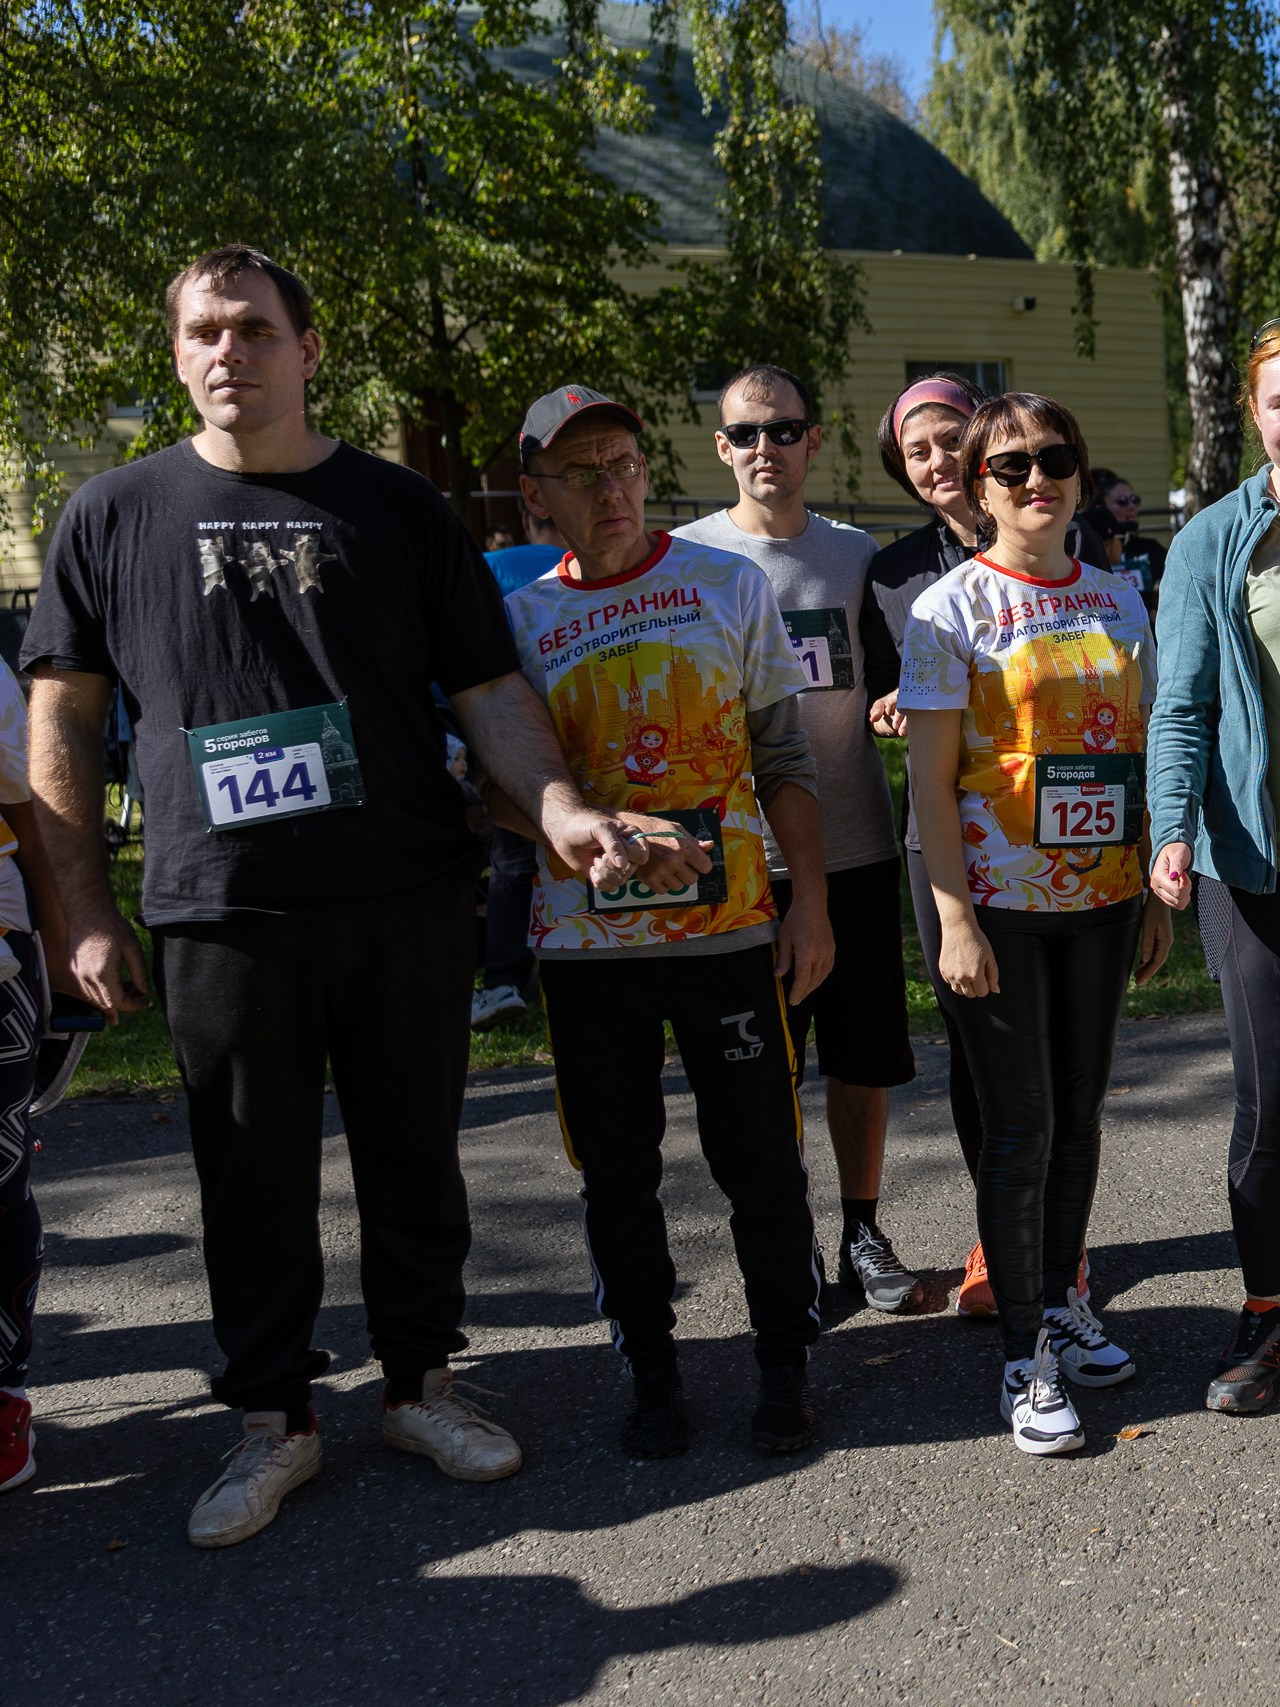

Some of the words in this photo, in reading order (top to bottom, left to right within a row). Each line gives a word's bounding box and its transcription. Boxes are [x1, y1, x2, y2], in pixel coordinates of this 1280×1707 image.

[198, 522, 235, 530] HAPPY
[242, 522, 280, 530] HAPPY
[286, 522, 324, 530] HAPPY
[997, 601, 1035, 627] БЕЗ
[1037, 591, 1118, 616] ГРАНИЦ
[538, 619, 582, 656] БЕЗ
[588, 588, 702, 632] ГРАНИЦ
[1053, 629, 1087, 644] ЗАБЕГ
[599, 638, 642, 663] ЗАБЕГ
[204, 738, 217, 753] 5
[217, 733, 270, 751] городов
[216, 731, 238, 743] серия
[239, 727, 268, 739] забегов
[265, 750, 277, 758] км
[1047, 766, 1056, 779] 5
[1056, 770, 1096, 780] городов
[217, 761, 318, 815] 144
[1052, 800, 1116, 837] 125
